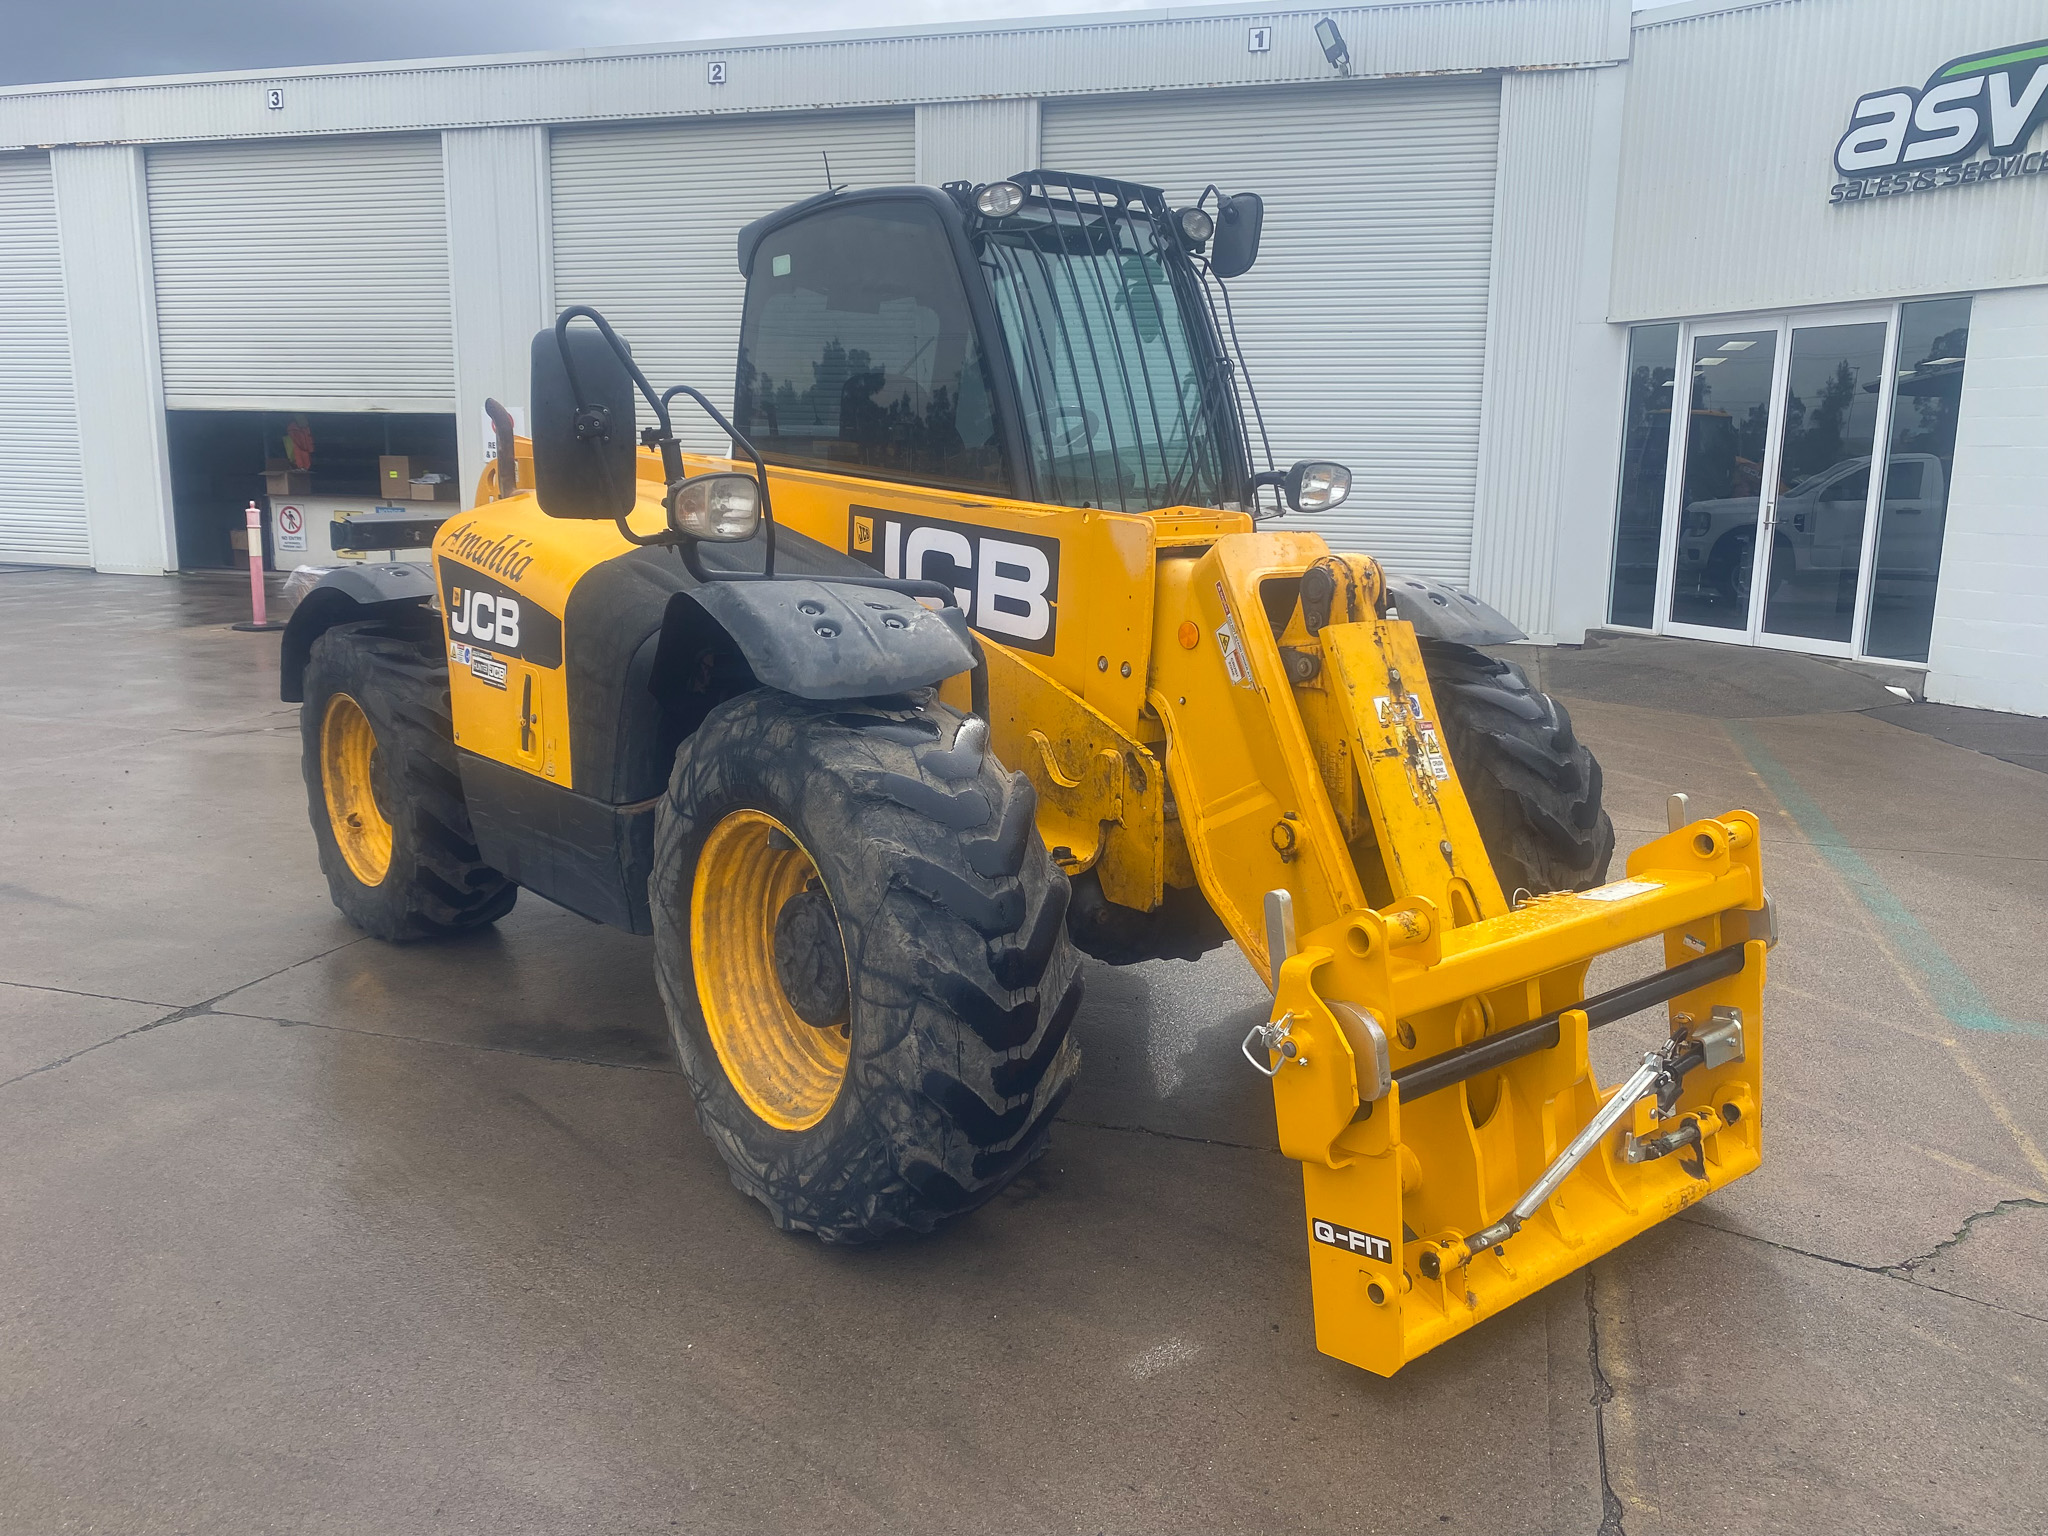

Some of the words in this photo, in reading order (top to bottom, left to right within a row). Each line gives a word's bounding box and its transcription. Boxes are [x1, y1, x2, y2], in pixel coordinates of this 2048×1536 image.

[1255, 30, 1264, 48] 1
[712, 64, 722, 81] 2
[271, 91, 280, 106] 3
[1837, 63, 2048, 171] asv
[440, 520, 534, 583] Amahlia
[451, 588, 520, 648] JCB
[1314, 1221, 1389, 1260] Q-FIT
